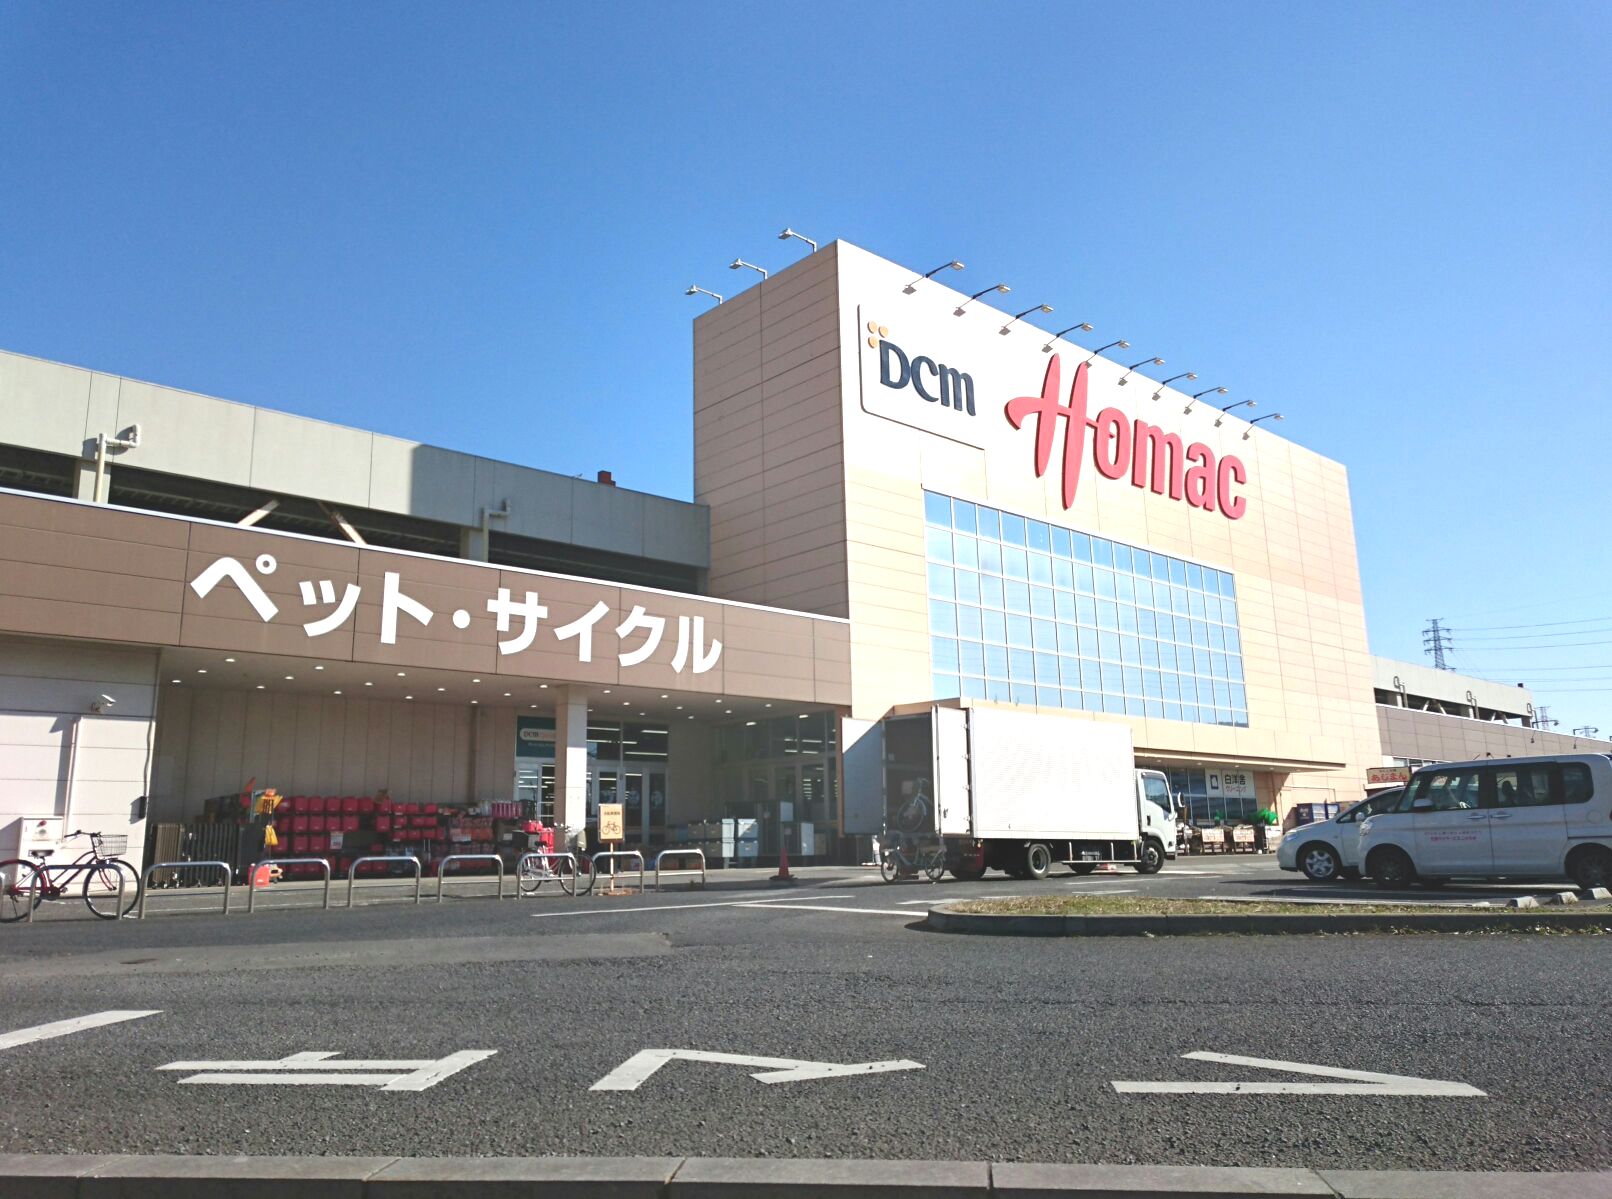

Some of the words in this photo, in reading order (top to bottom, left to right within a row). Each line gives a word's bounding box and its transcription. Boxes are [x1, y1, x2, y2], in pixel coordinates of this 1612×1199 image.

[1004, 352, 1248, 521] Homac
[190, 553, 723, 675] ペット・サイクル
